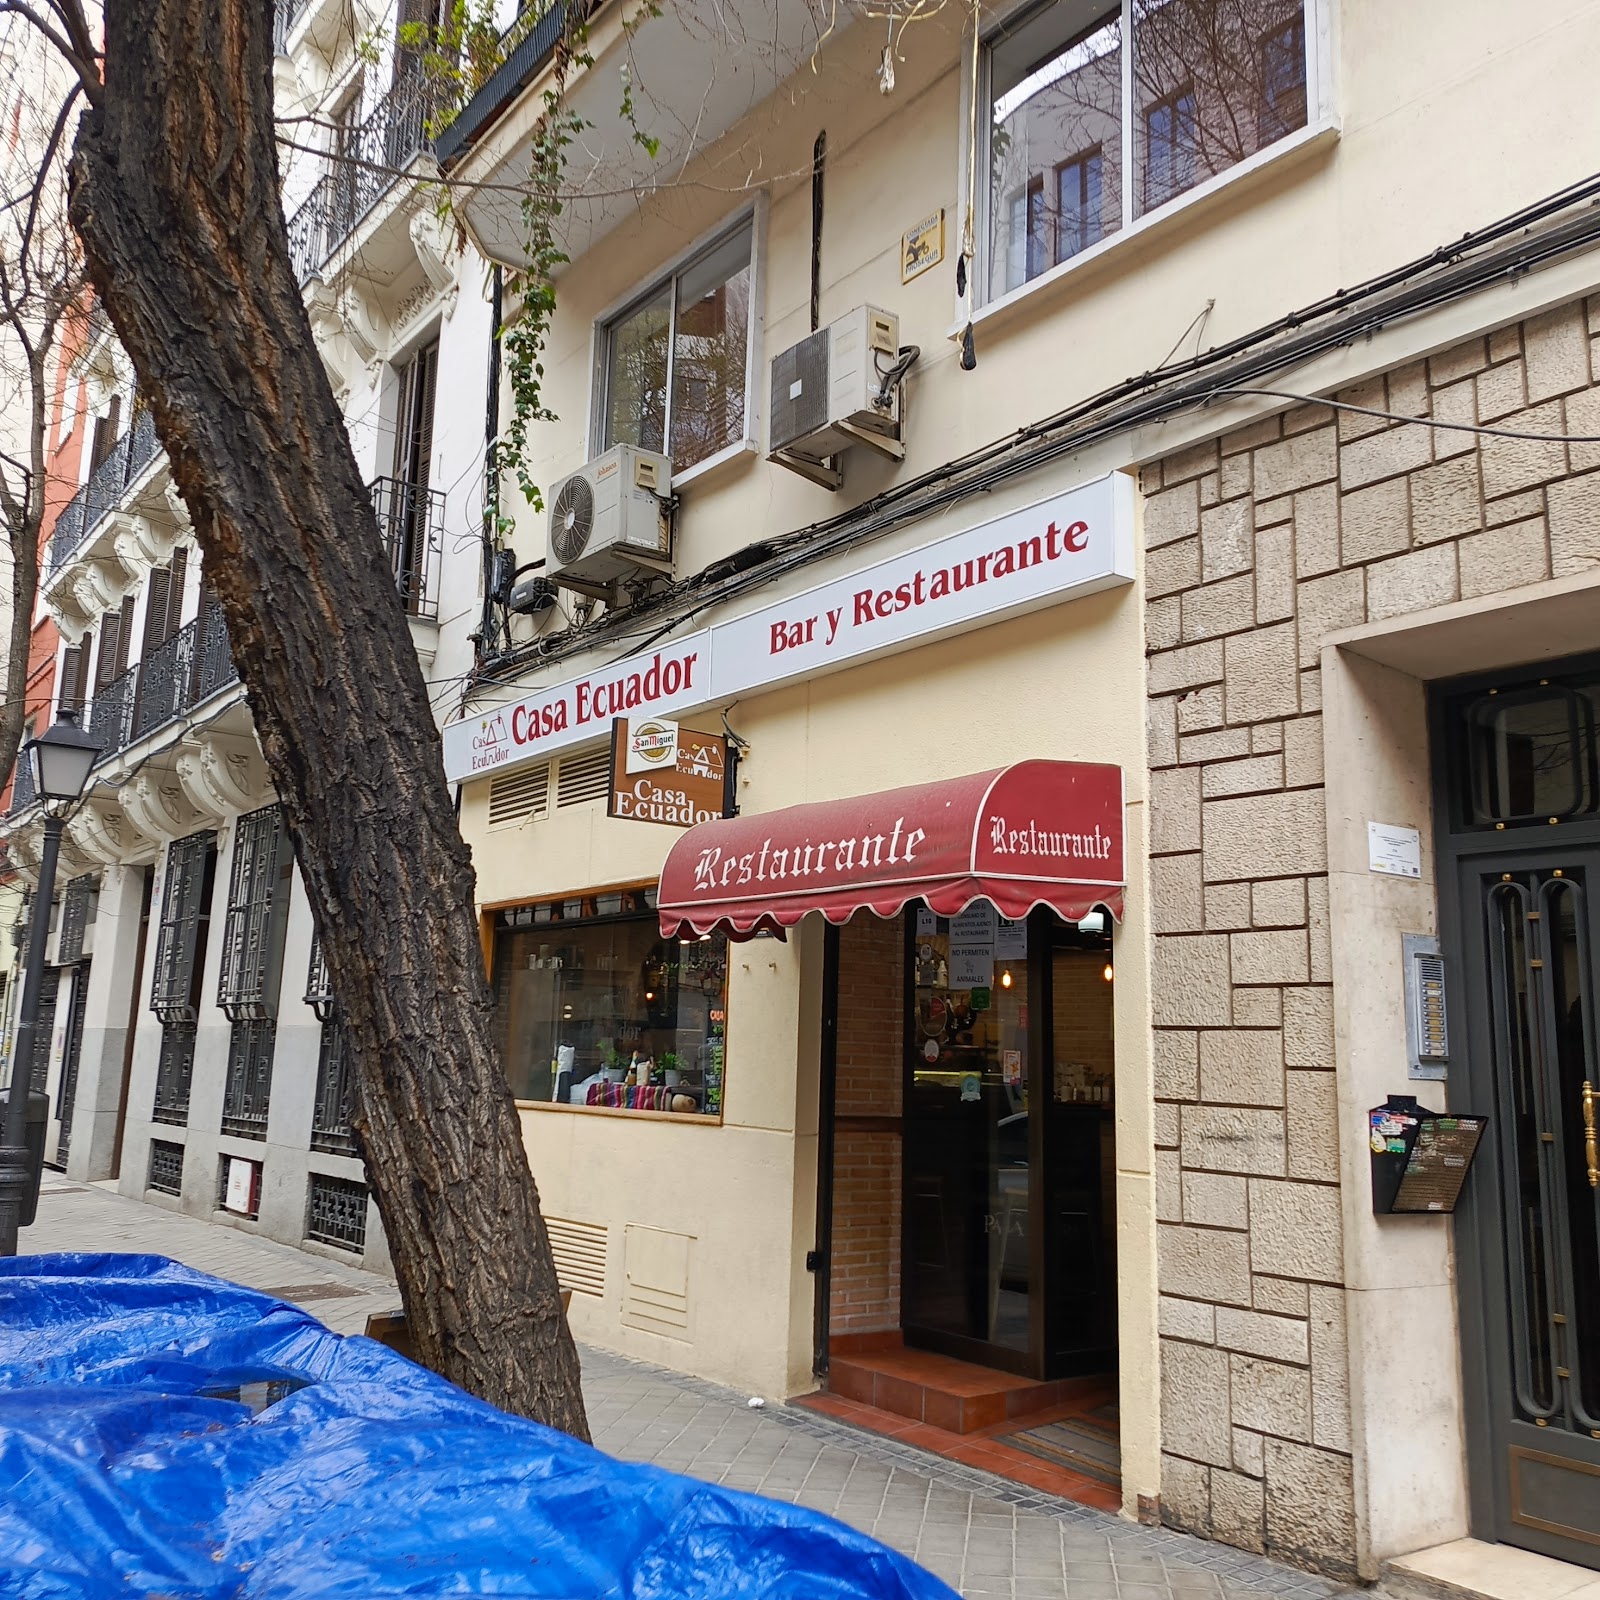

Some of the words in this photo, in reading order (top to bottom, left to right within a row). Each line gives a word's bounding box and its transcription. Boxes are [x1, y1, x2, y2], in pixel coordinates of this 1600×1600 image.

[905, 249, 938, 274] PROSEGUR
[769, 615, 818, 655] Bar
[825, 606, 843, 646] y
[852, 520, 1089, 626] Restaurante
[512, 699, 568, 745] Casa
[575, 652, 697, 725] Ecuador
[614, 791, 723, 824] Ecuador
[634, 779, 687, 806] Casa
[990, 815, 1112, 859] Restaurante
[693, 817, 925, 891] Restaurante
[961, 948, 990, 956] PERMITEN
[956, 975, 984, 983] ANIMALES
